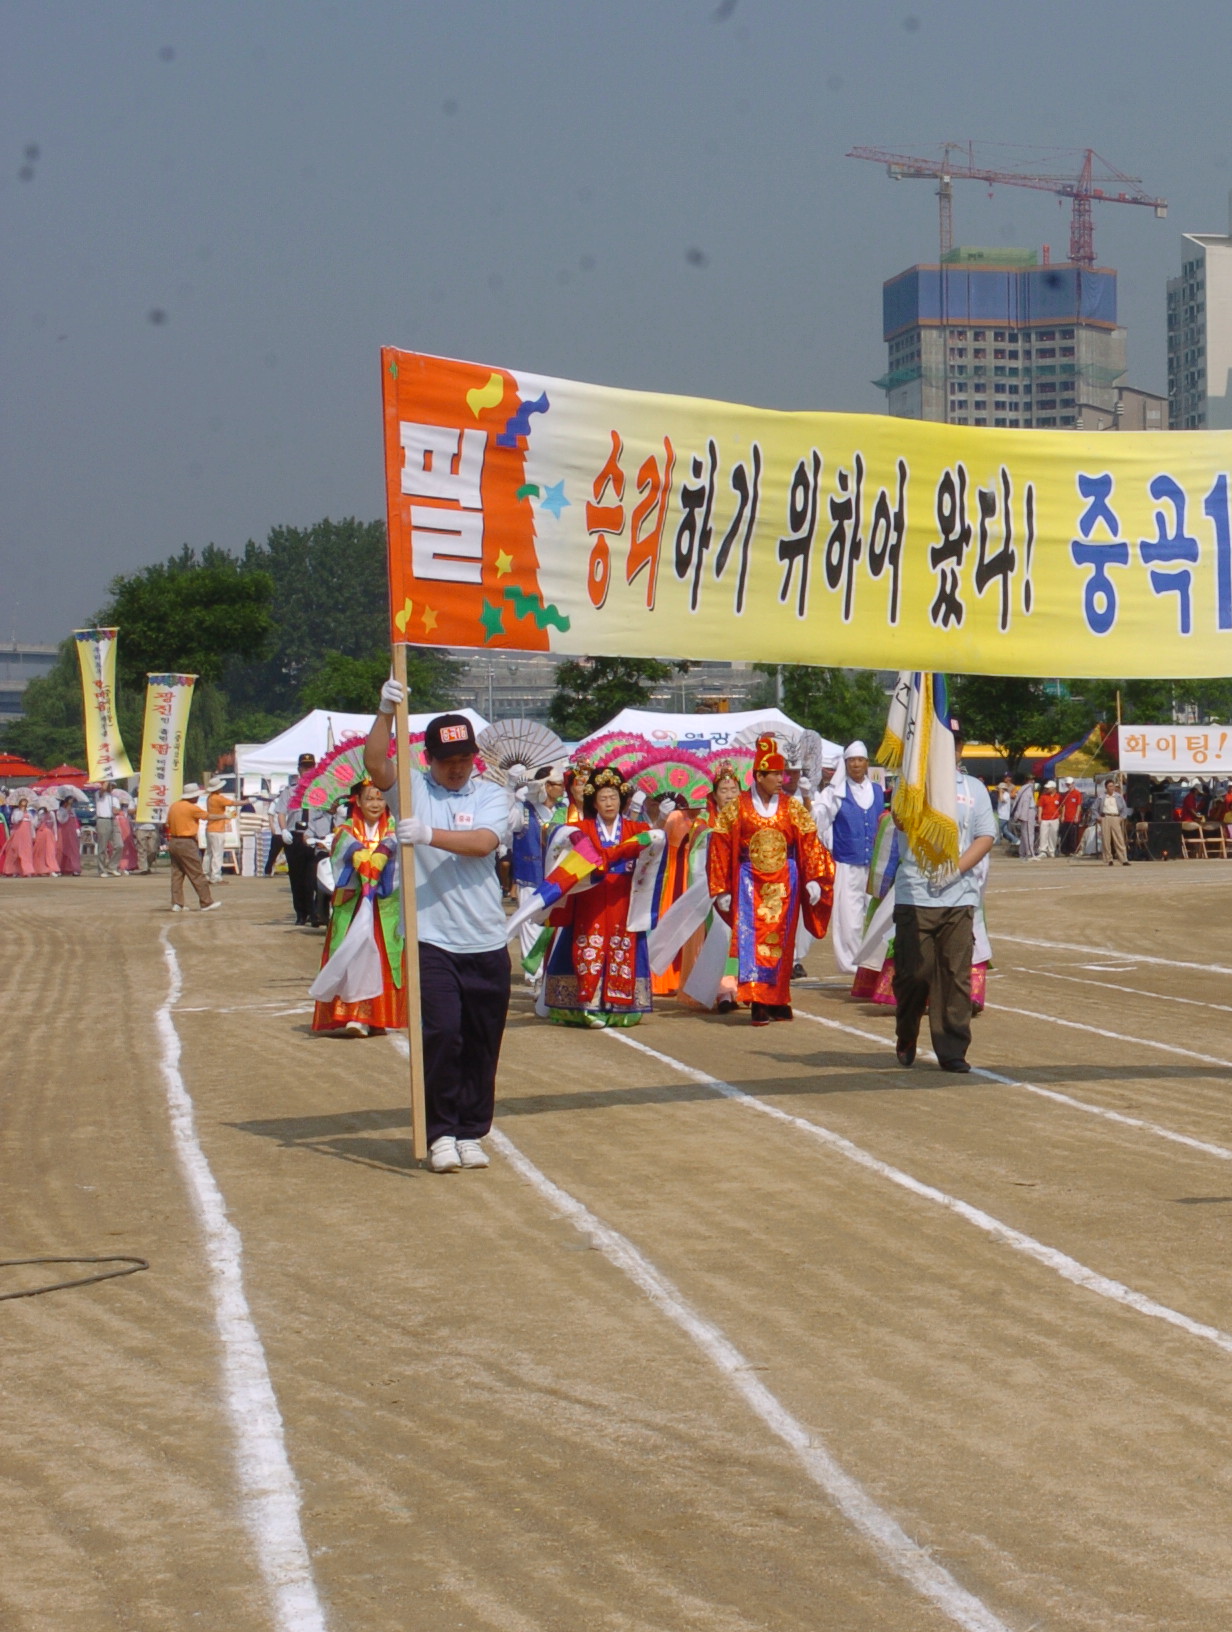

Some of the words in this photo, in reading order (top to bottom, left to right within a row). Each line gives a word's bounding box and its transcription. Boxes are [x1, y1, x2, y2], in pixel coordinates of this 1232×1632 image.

[400, 421, 487, 584] 필
[585, 430, 761, 614] 승리하기
[778, 450, 907, 624] 위하여
[930, 464, 1033, 630] 왔다!
[1124, 732, 1228, 763] 화이팅!
